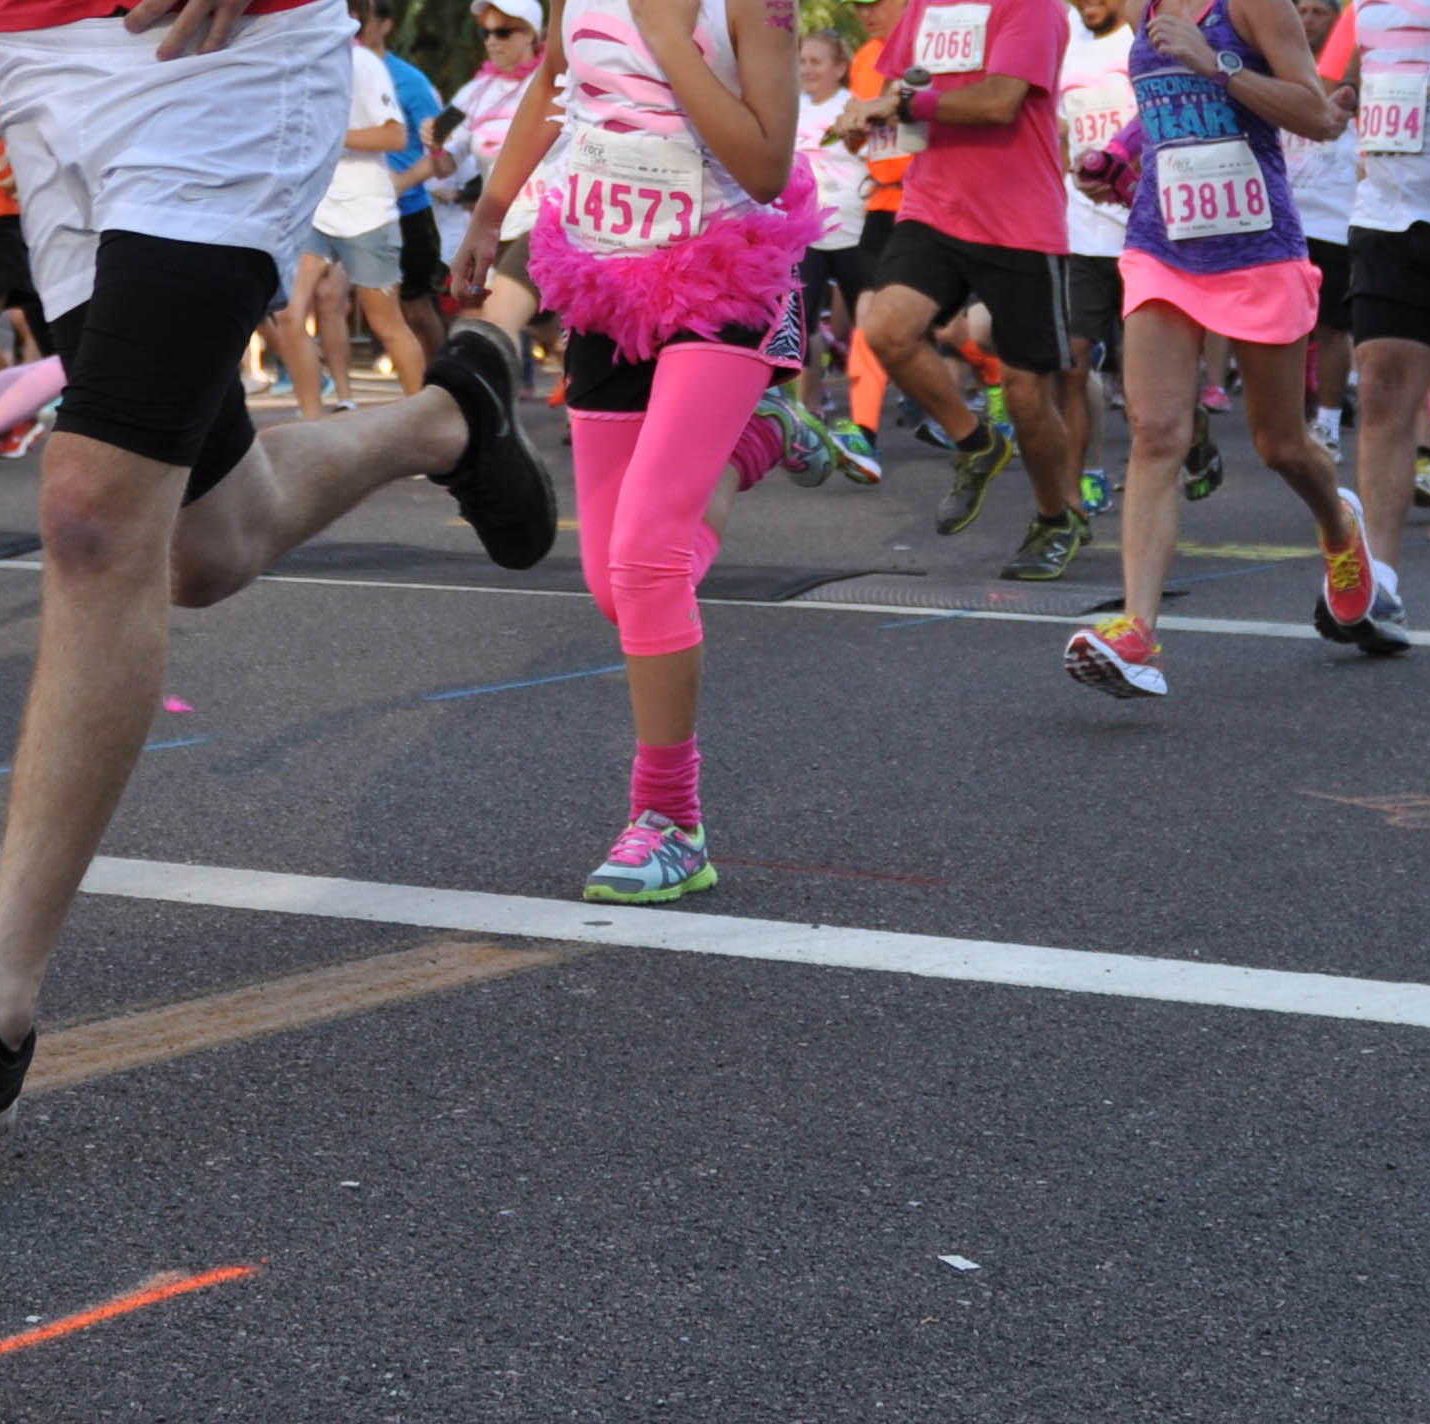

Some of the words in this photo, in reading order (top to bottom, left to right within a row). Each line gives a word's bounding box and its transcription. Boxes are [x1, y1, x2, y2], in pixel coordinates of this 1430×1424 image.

[922, 30, 973, 61] 7068
[1074, 109, 1122, 144] 9375
[1141, 100, 1241, 144] FEAR
[565, 173, 694, 242] 14573
[1163, 177, 1265, 225] 13818
